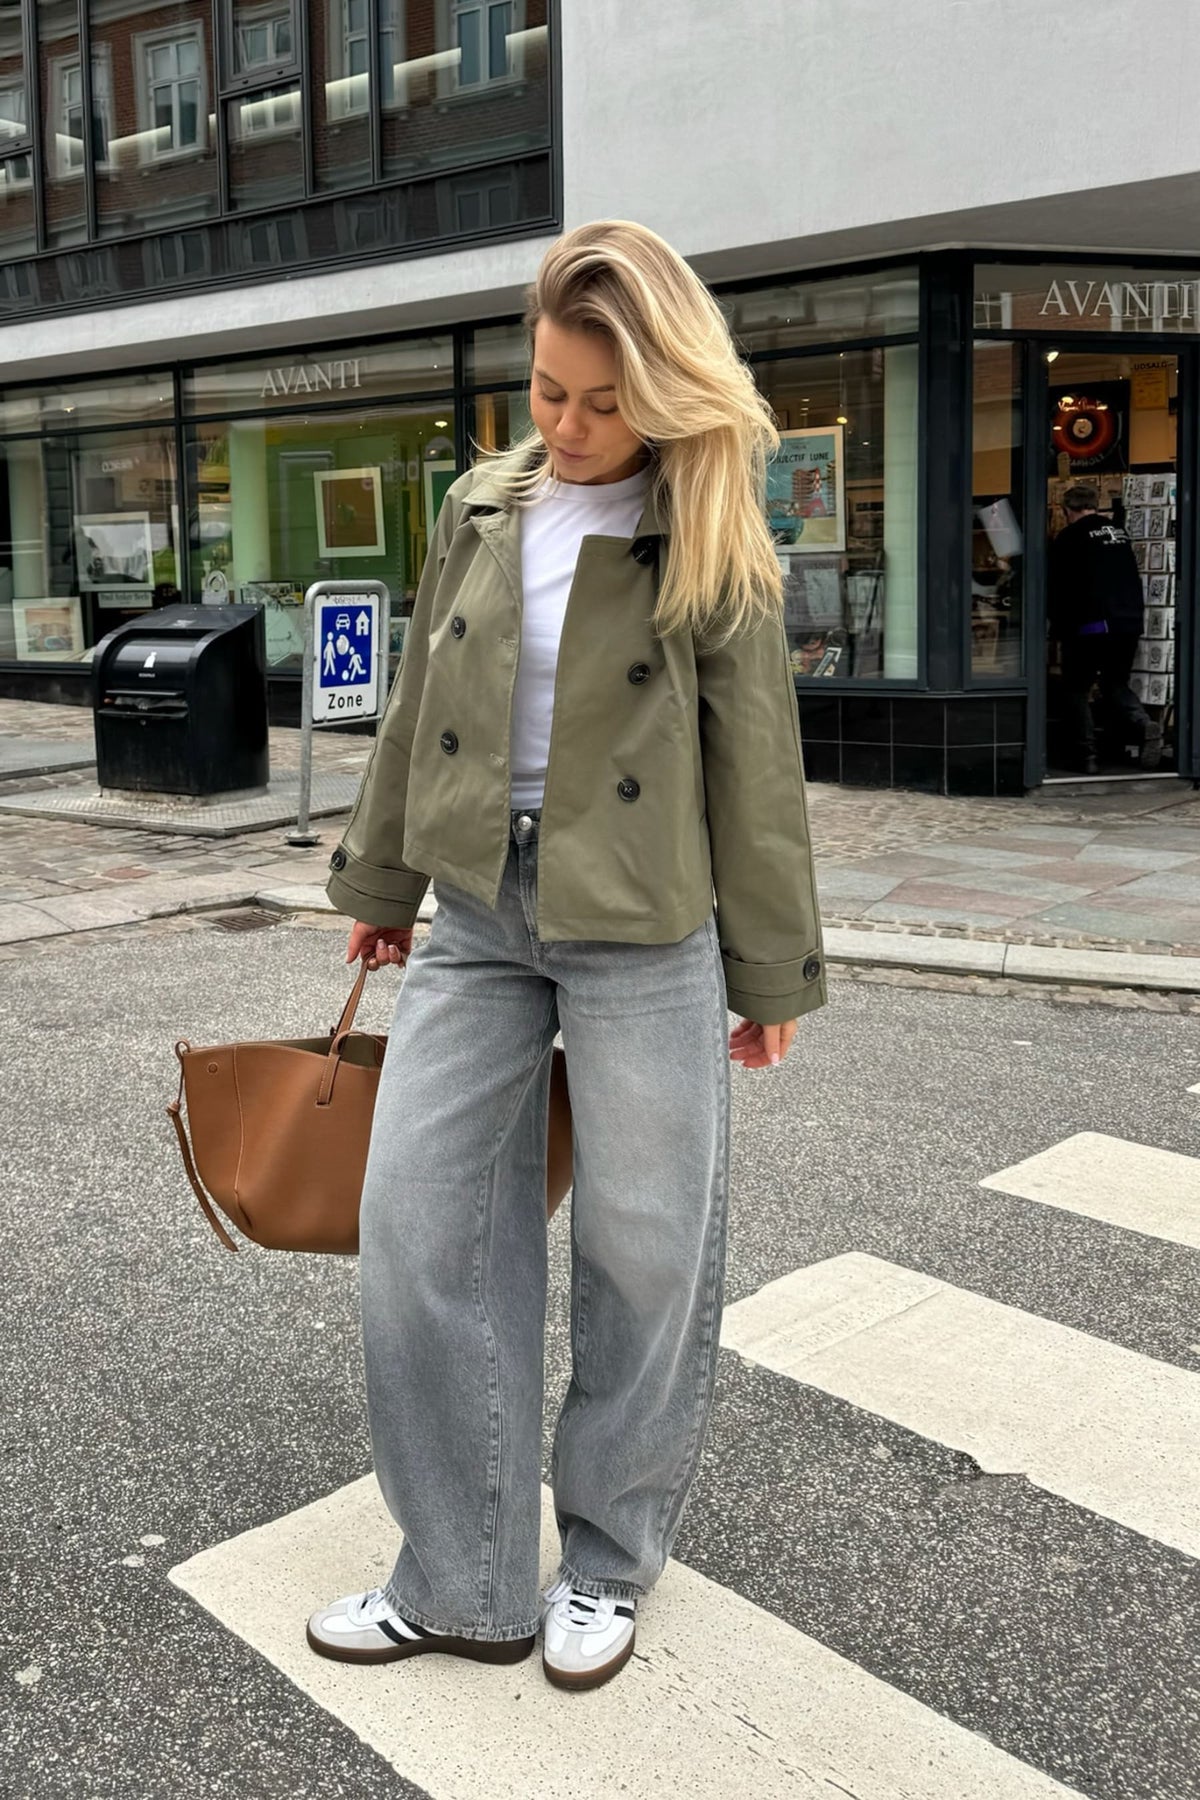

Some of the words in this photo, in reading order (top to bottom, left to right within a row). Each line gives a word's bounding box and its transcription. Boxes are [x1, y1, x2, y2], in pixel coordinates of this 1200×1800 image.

[1038, 279, 1193, 319] AVANTI
[260, 359, 362, 398] AVANTI
[809, 452, 830, 461] LUNE
[328, 693, 363, 710] Zone
